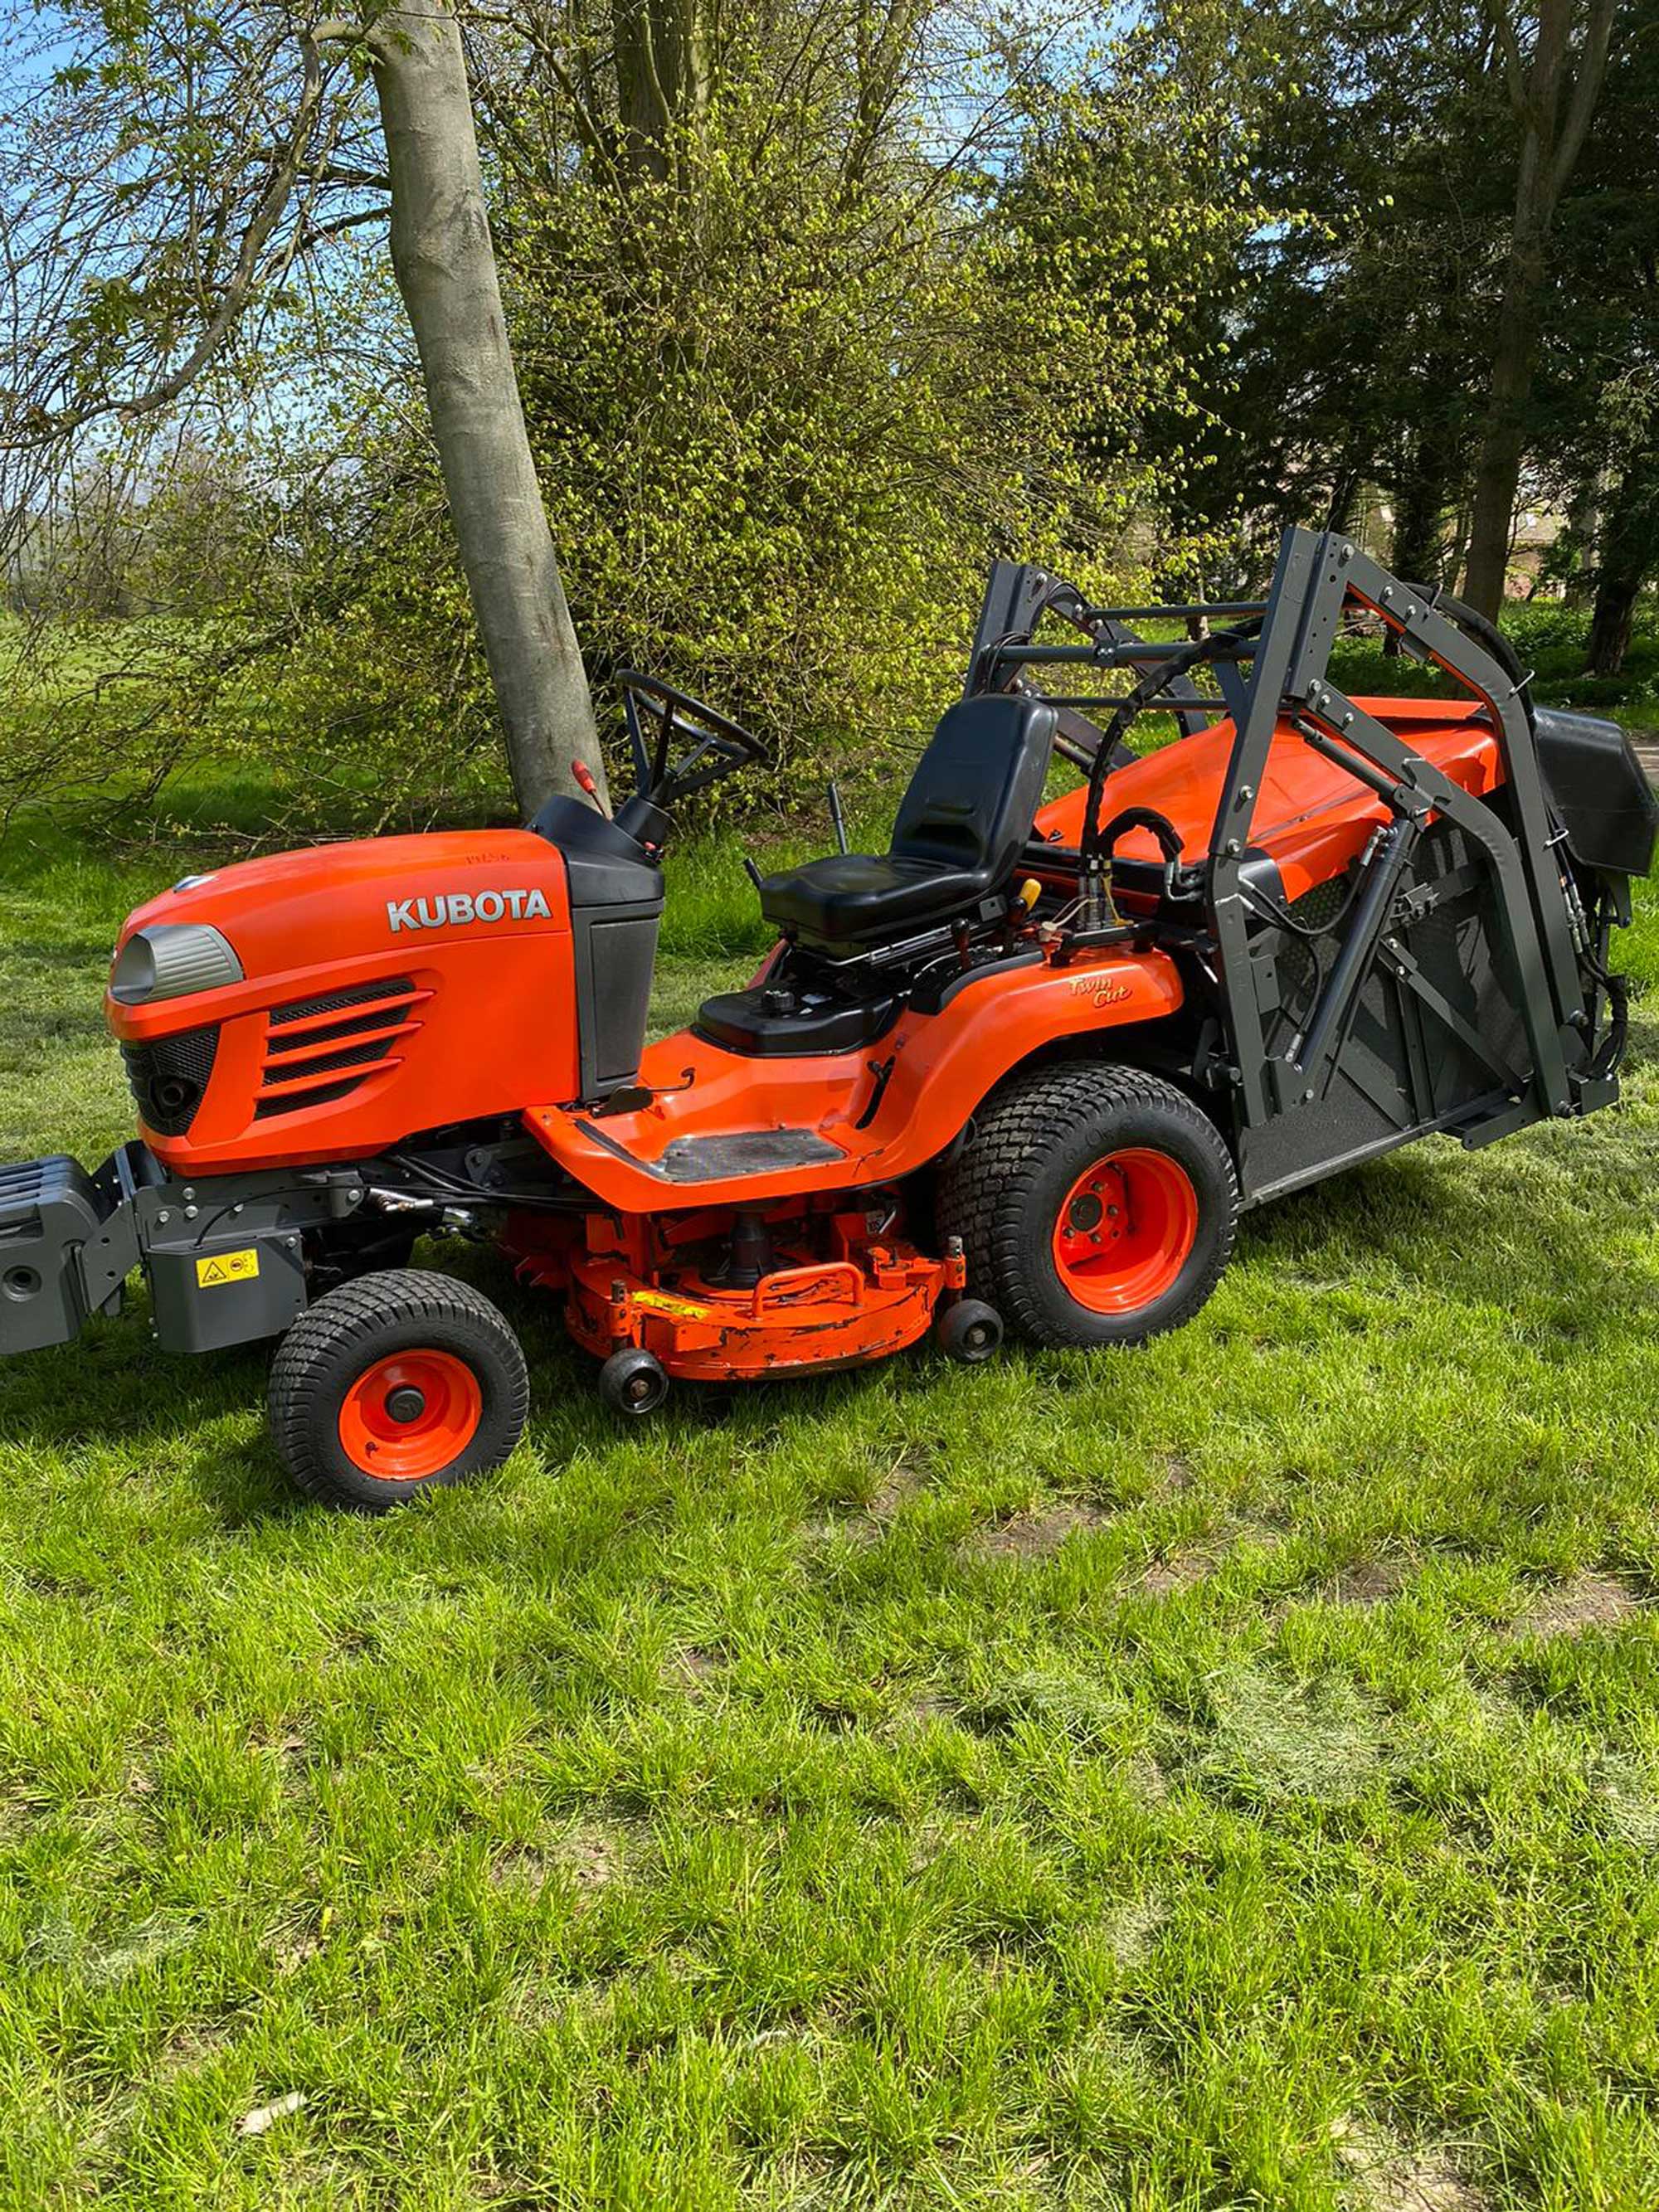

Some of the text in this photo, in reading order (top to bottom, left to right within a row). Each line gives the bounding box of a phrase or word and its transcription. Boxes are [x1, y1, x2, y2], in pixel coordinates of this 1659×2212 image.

[387, 889, 552, 932] KUBOTA
[1068, 977, 1112, 996] Twin
[1093, 985, 1133, 1009] Cut
